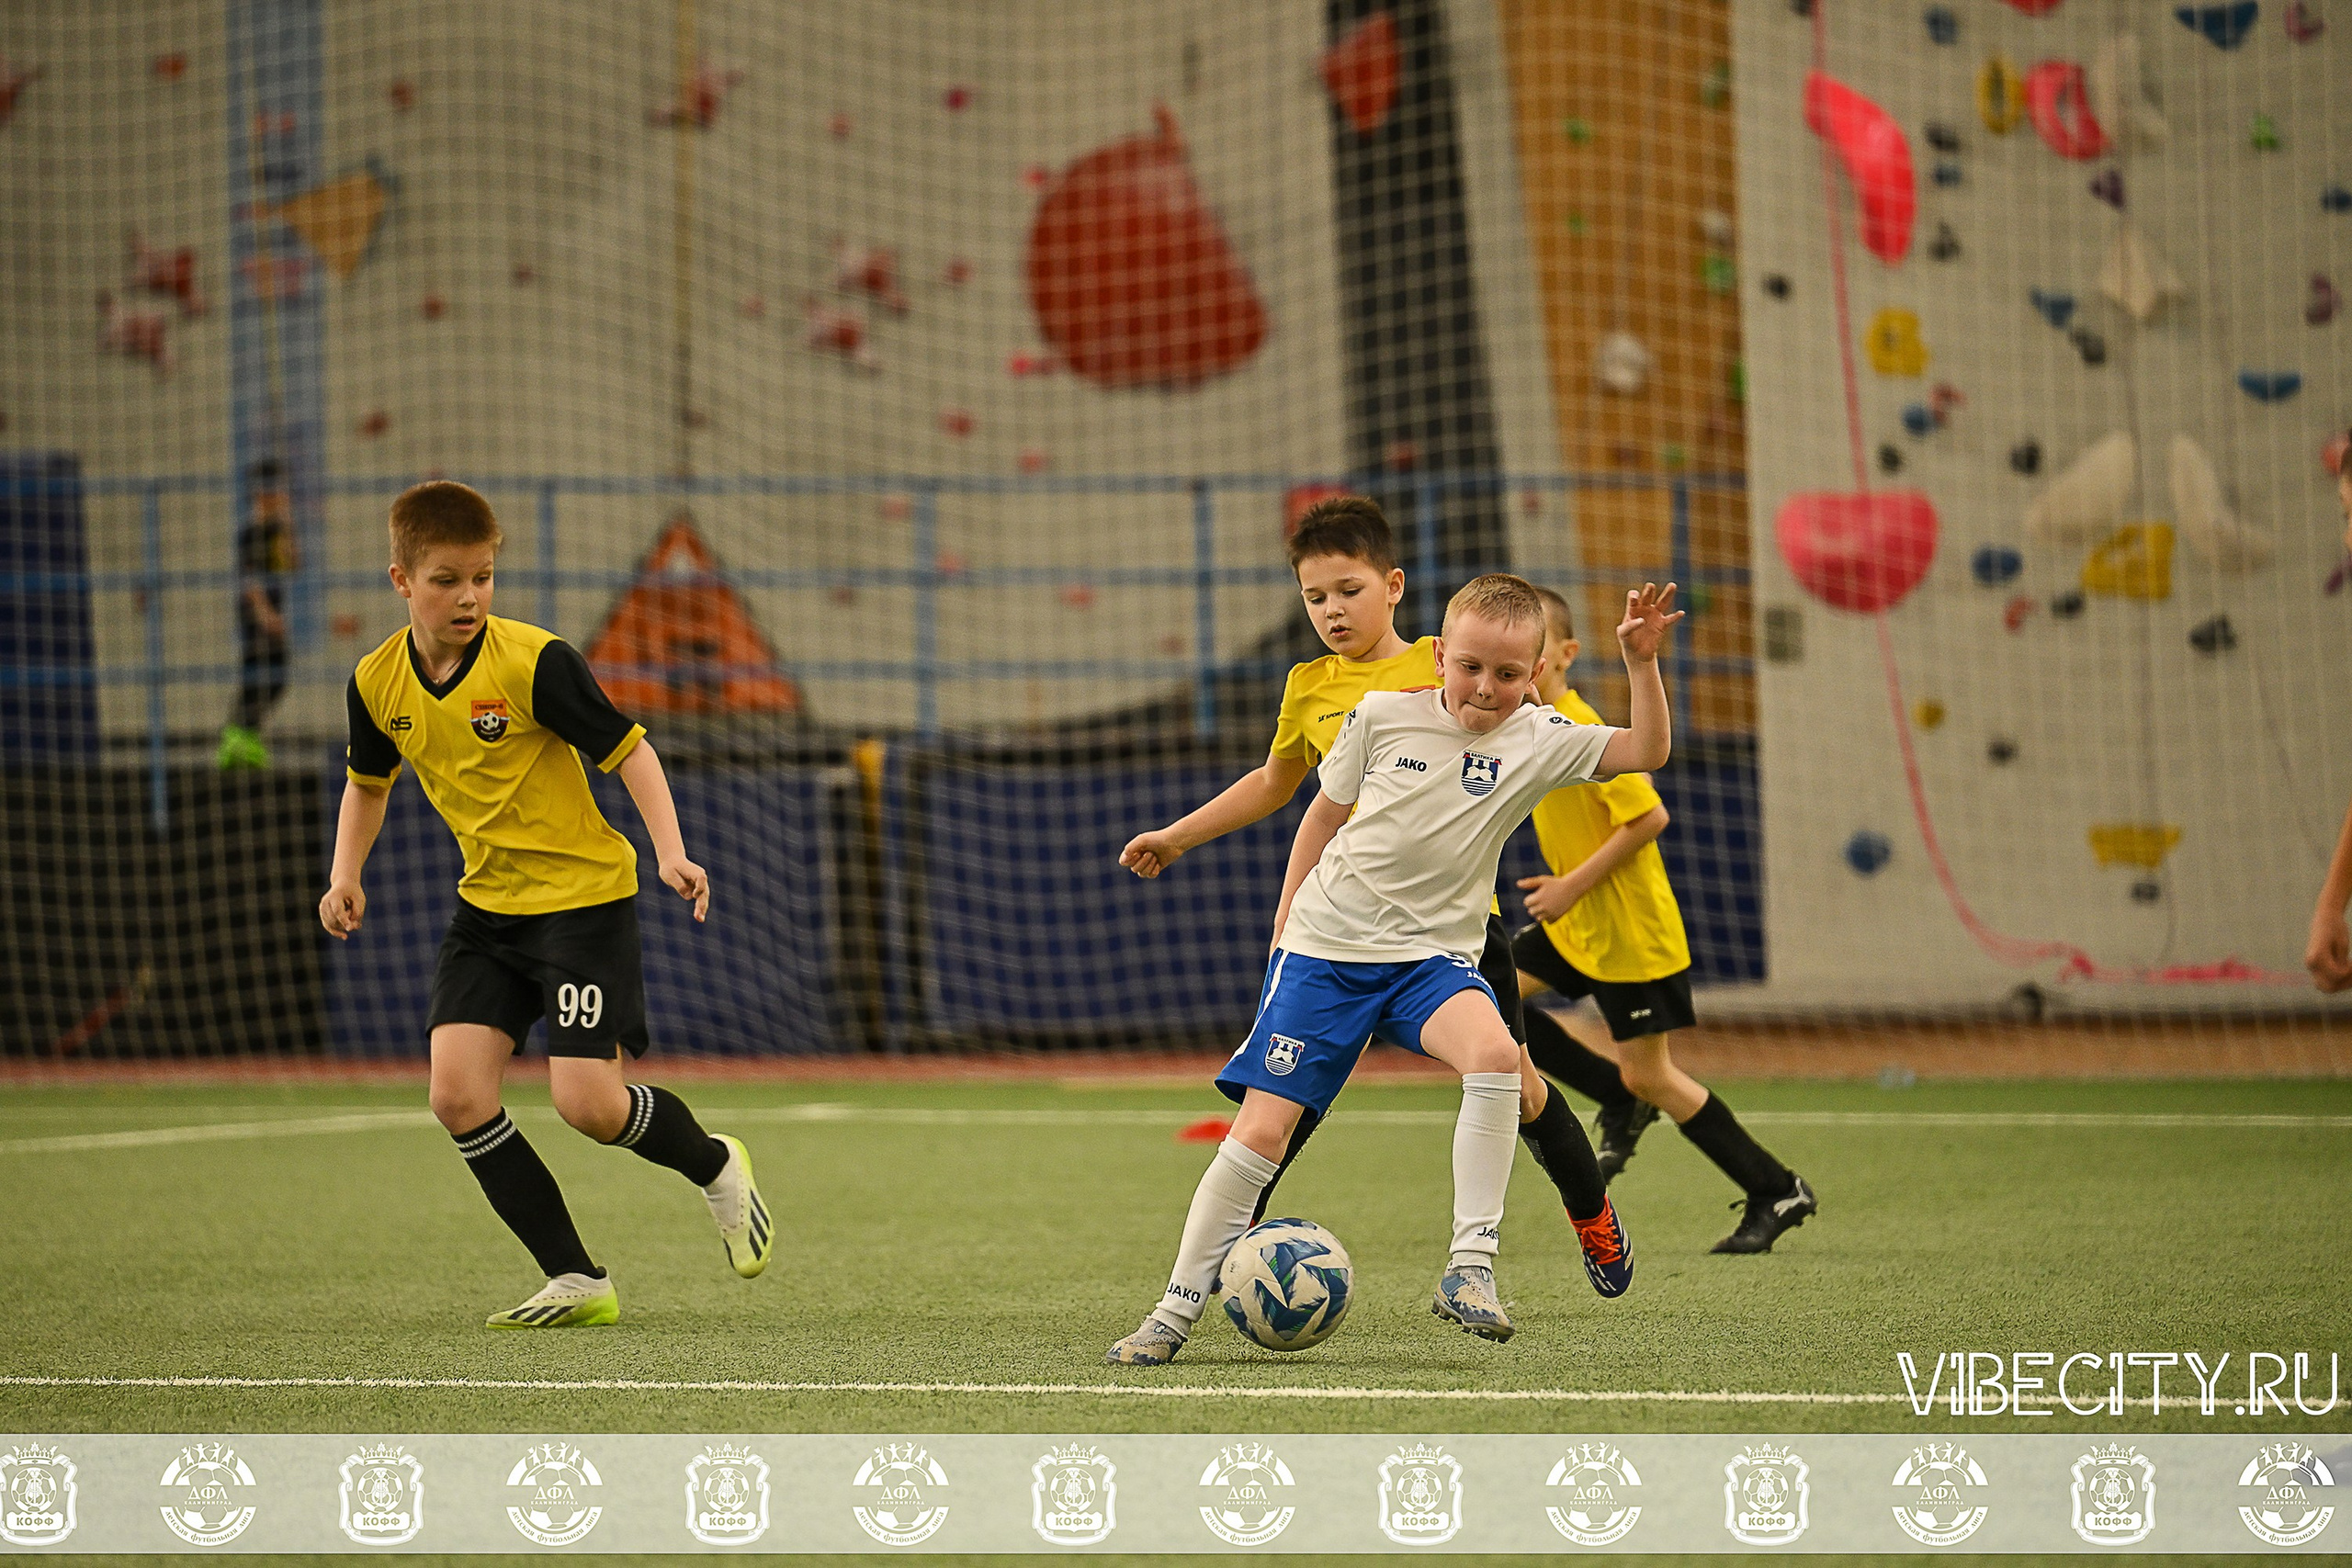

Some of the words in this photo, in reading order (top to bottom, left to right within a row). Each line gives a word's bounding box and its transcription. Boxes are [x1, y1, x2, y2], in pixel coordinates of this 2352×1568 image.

[1396, 757, 1427, 772] JAKO
[1471, 752, 1494, 761] БАЛТИКА
[558, 983, 603, 1028] 99
[1168, 1282, 1201, 1303] JAKO
